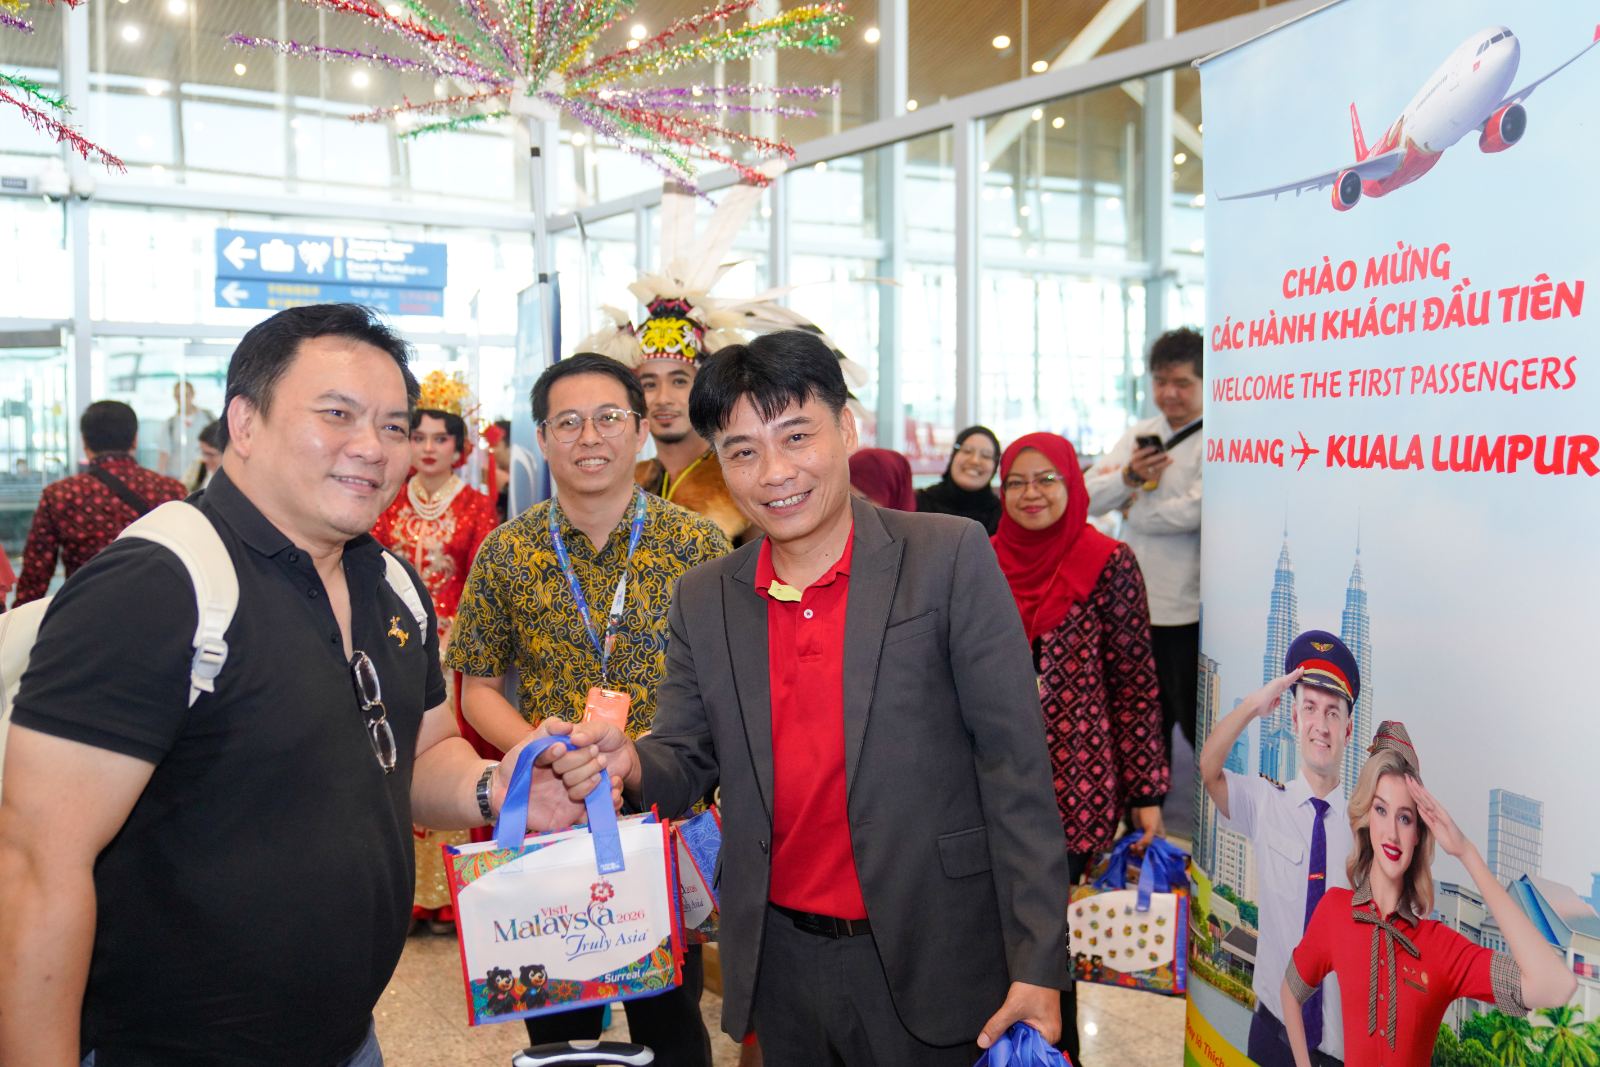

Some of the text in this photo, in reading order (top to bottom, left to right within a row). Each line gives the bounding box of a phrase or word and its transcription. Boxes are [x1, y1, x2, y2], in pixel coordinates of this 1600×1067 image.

[1282, 240, 1451, 299] CHÀO MỪNG
[1211, 273, 1585, 352] CÁC HÀNH KHÁCH ĐẦU TIÊN
[1212, 355, 1578, 402] WELCOME THE FIRST PASSENGERS
[1206, 433, 1600, 477] DA NANG KUALA LUMPUR
[493, 900, 645, 943] Malaysia 2026
[565, 931, 647, 962] Truly Asia
[604, 968, 642, 985] Surreal
